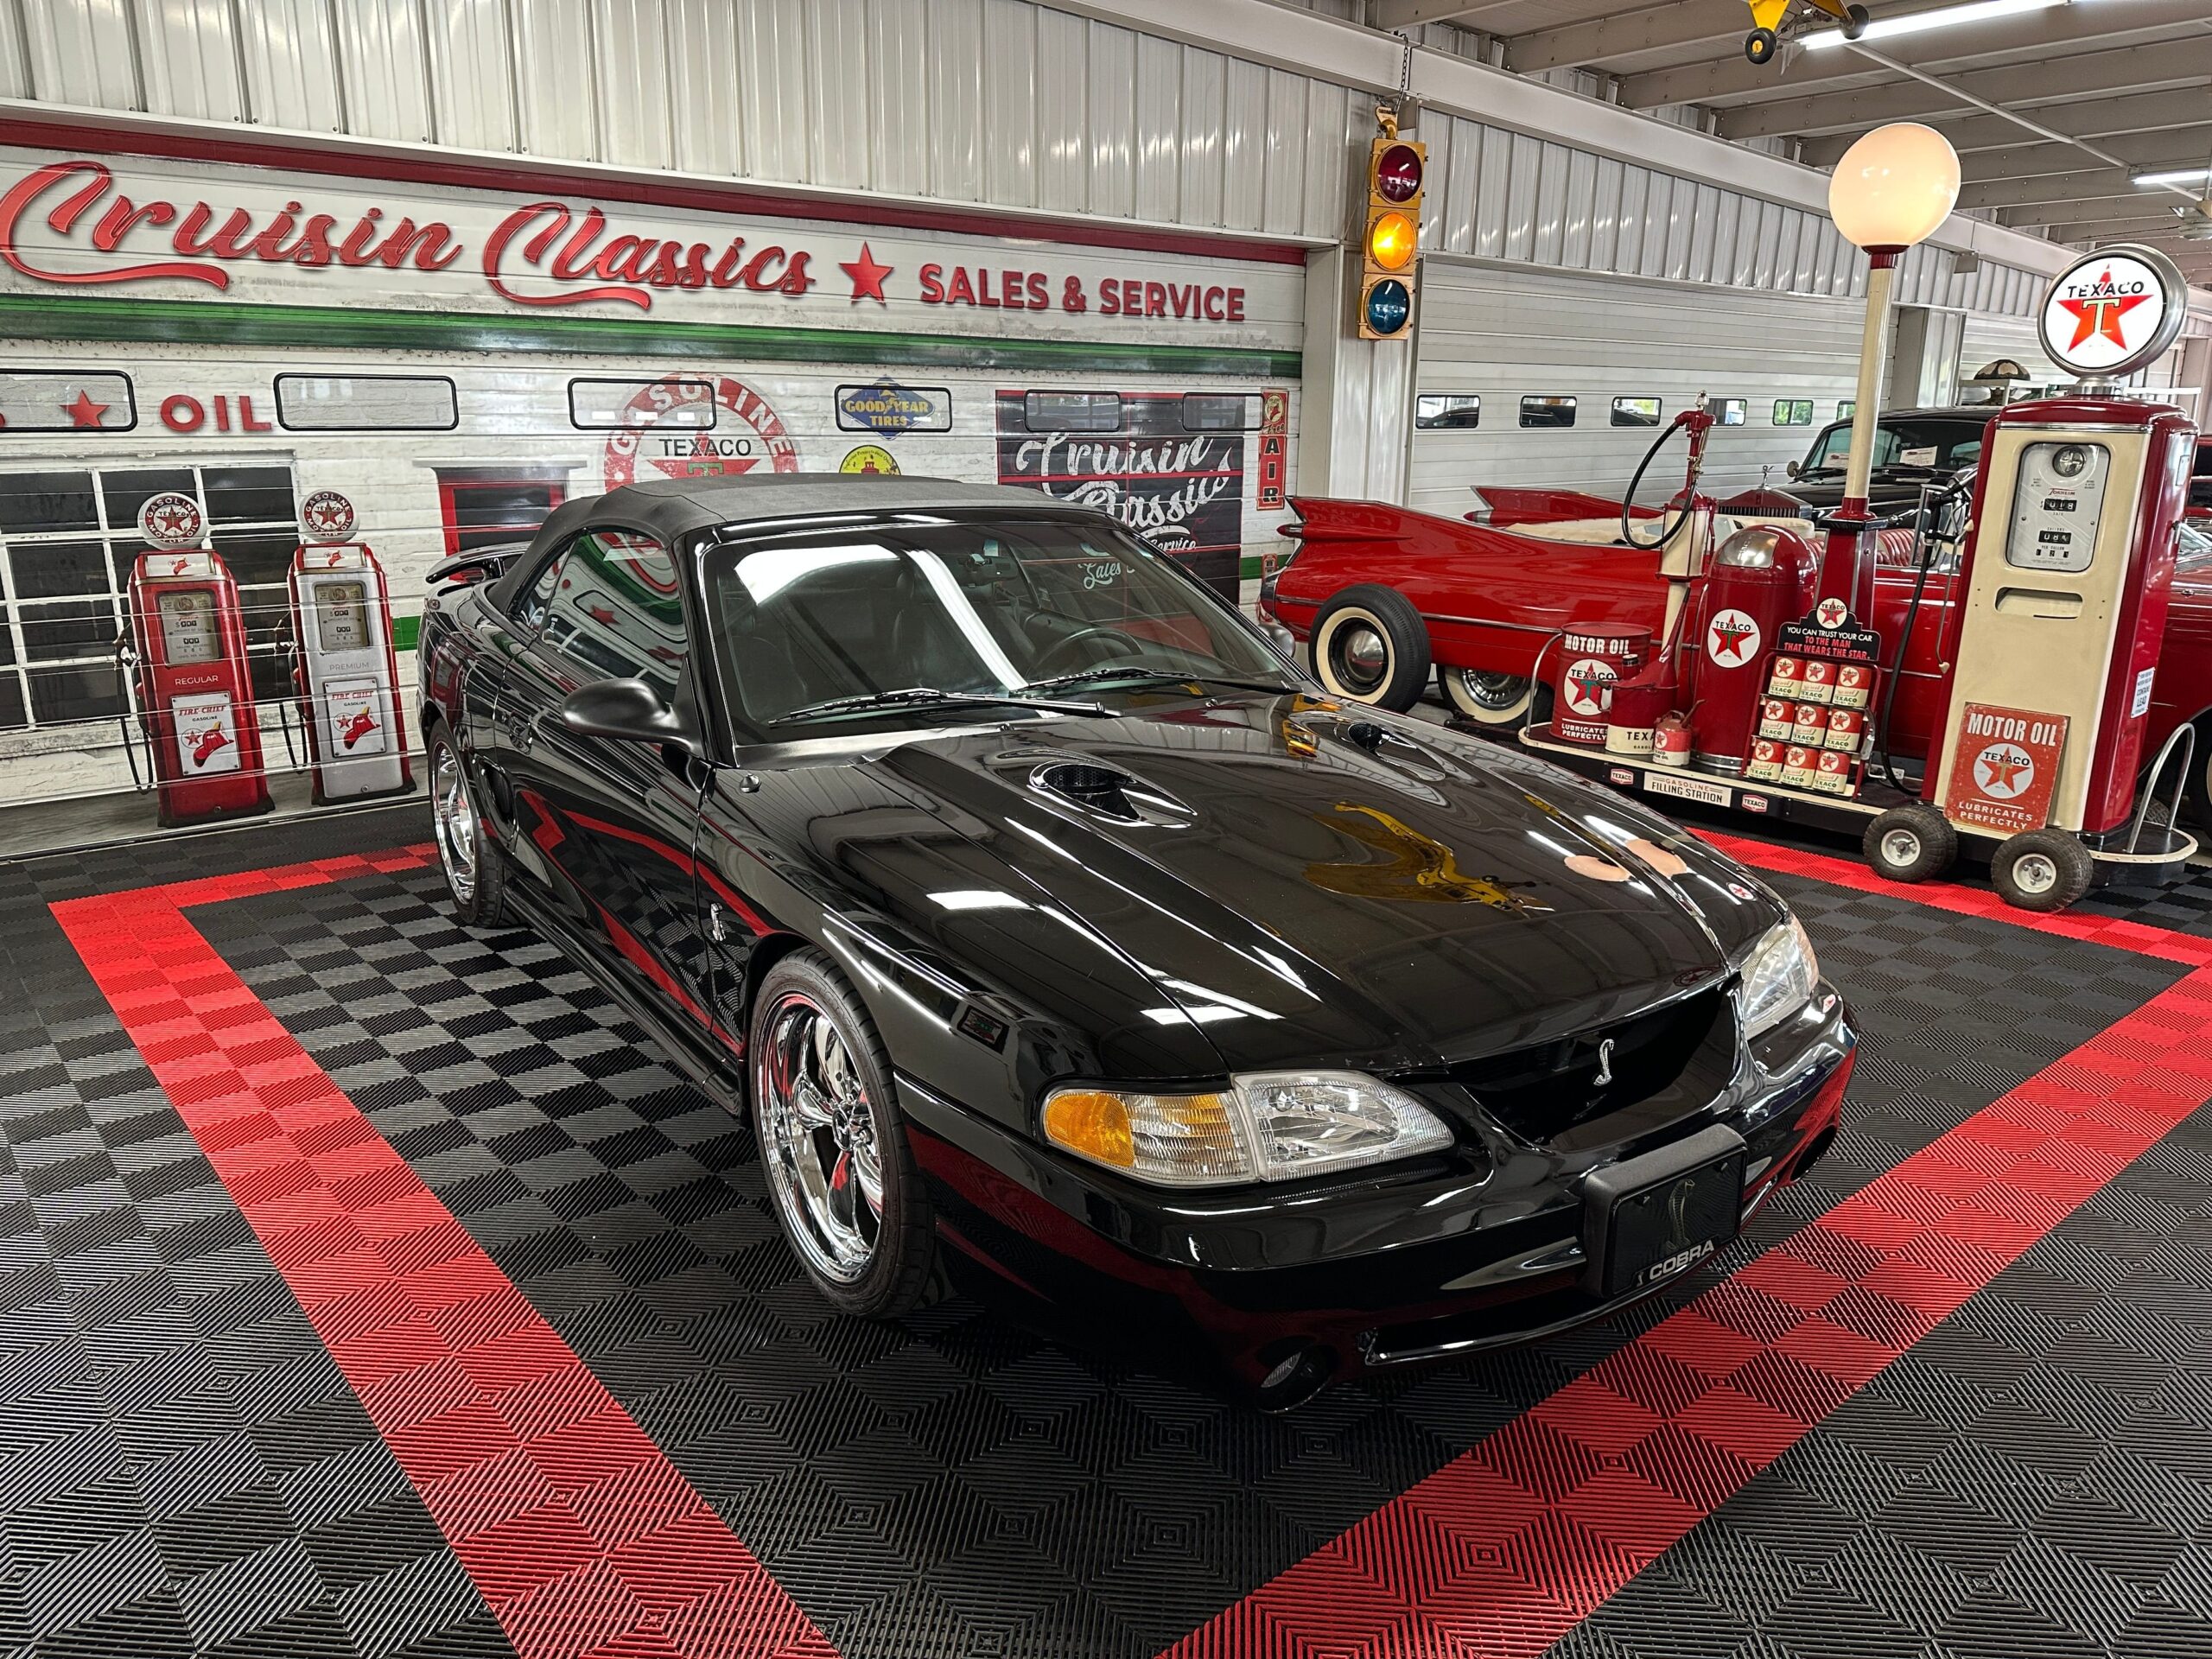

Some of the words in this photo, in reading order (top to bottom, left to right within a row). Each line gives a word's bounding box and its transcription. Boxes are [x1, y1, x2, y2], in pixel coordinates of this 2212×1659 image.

[0, 161, 462, 290] Cruisin
[482, 201, 816, 310] Classics
[919, 264, 1049, 309] SALES
[1063, 275, 1086, 312] &
[1098, 278, 1245, 321] SERVICE
[2068, 281, 2145, 298] TEXACO
[160, 394, 272, 431] OIL
[869, 416, 907, 427] TIRES
[659, 439, 752, 456] TEXACO
[1016, 430, 1213, 480] Cruisin
[1263, 437, 1281, 504] AIR
[147, 497, 197, 518] GASOLINE
[306, 493, 351, 512] GASOLINE
[1715, 620, 1751, 632] TEXACO
[1787, 626, 1802, 634] YOU
[1802, 628, 1817, 637] CAN
[1818, 629, 1838, 639] TRUST
[1838, 632, 1857, 641] YOUR
[1858, 633, 1872, 642] CAR
[1565, 634, 1605, 654] MOTOR
[1610, 639, 1630, 654] OIL
[1784, 642, 1802, 652] THAT
[1803, 645, 1831, 656] WEARS
[1831, 646, 1847, 658] THE
[1848, 650, 1871, 660] STAR.
[1816, 637, 1829, 646] THE
[1831, 639, 1851, 648] MAN
[329, 662, 370, 671] PREMIUM
[1571, 668, 1614, 680] TEXACO
[175, 675, 219, 685] REGULAR
[1967, 712, 2027, 742] MOTOR
[2031, 721, 2057, 747] OIL
[1984, 752, 2031, 766] TEXACO
[1611, 772, 1631, 781] TEXACO
[1666, 779, 1710, 791] GASOLINE
[1651, 781, 1683, 796] FILLING
[1686, 788, 1723, 803] STATION
[1744, 799, 1765, 808] TEXACO
[1958, 802, 2033, 822] LUBRICATES
[1960, 811, 2028, 830] PERFECTLY
[1649, 1239, 1714, 1281] COBRA
